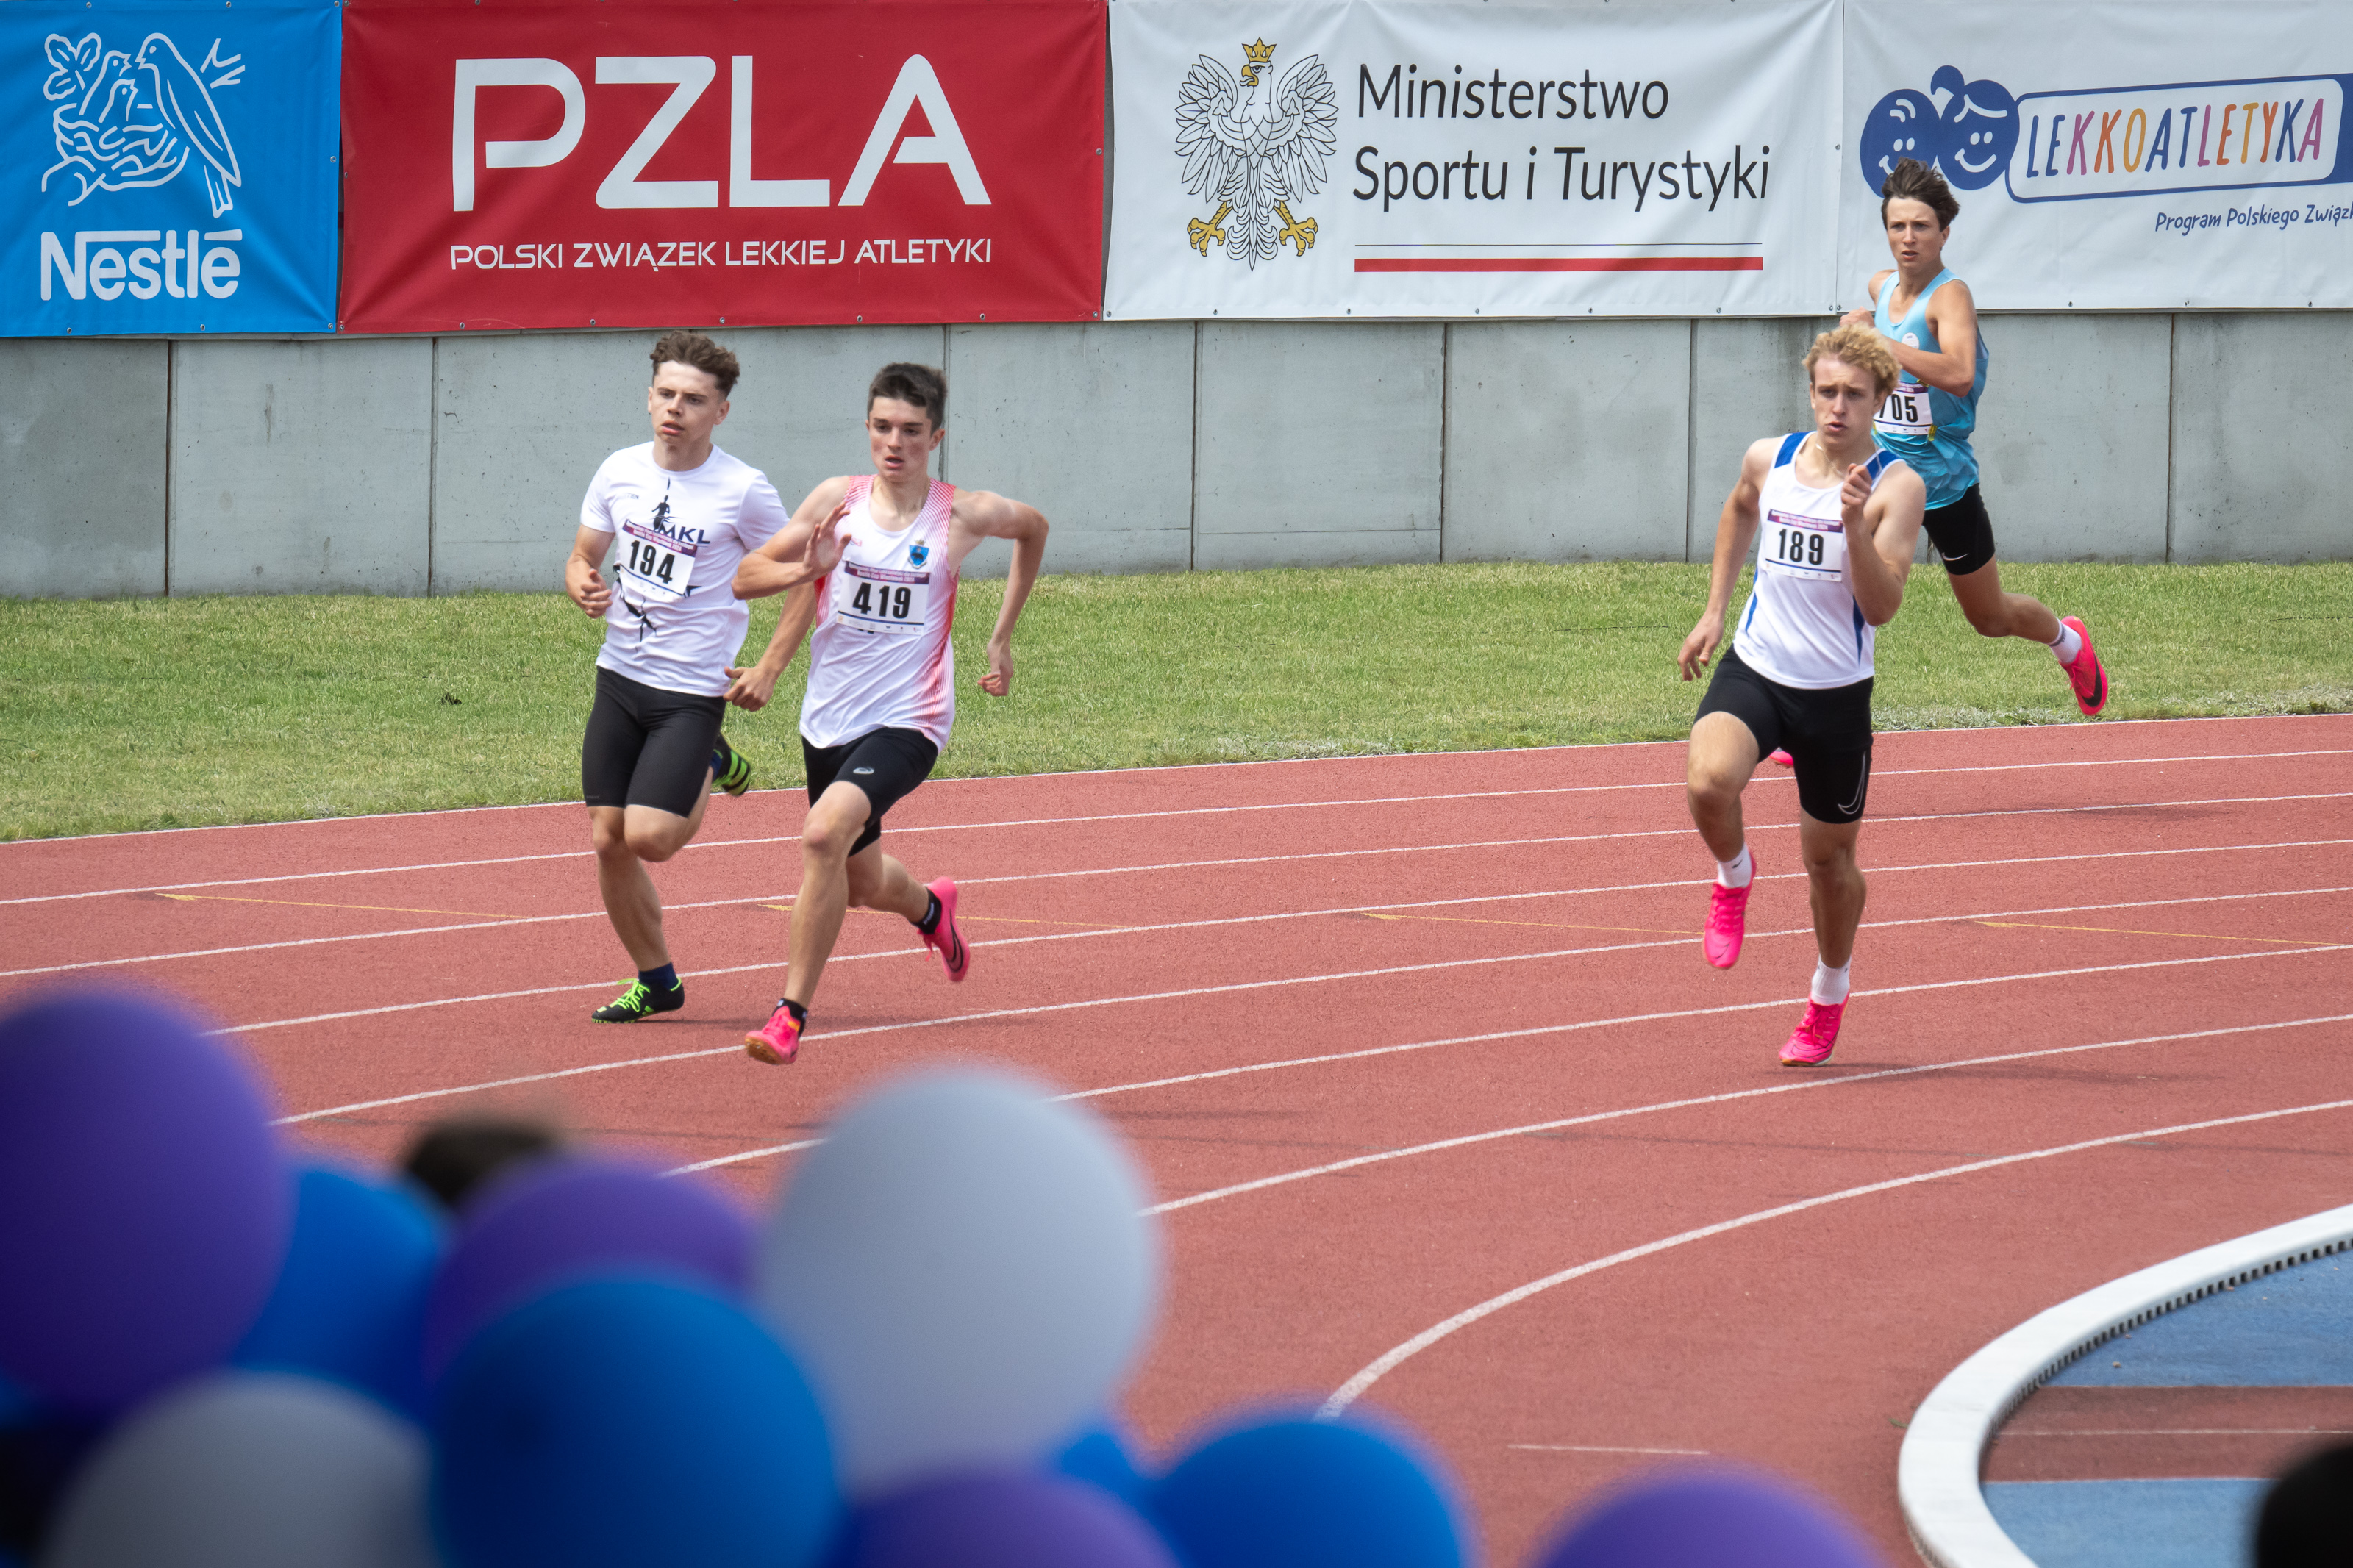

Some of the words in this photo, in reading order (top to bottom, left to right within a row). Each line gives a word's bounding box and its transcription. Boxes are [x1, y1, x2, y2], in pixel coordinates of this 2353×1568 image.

[1358, 63, 1668, 120] Ministerstwo
[451, 54, 992, 212] PZLA
[2026, 98, 2324, 179] LEKKOATLETYKA
[1352, 146, 1508, 212] Sportu
[1526, 146, 1538, 200] i
[1554, 144, 1771, 212] Turystyki
[2154, 212, 2222, 237] Program
[2226, 204, 2299, 231] Polskiego
[40, 229, 243, 301] Nestlé
[450, 243, 563, 271] POLSKI
[573, 241, 717, 272] ZWIĄZEK
[725, 240, 845, 266] LEKKIEJ
[854, 238, 991, 264] ATLETYKI
[629, 540, 673, 584] 194
[1779, 529, 1824, 565] 189
[852, 582, 911, 619] 419
